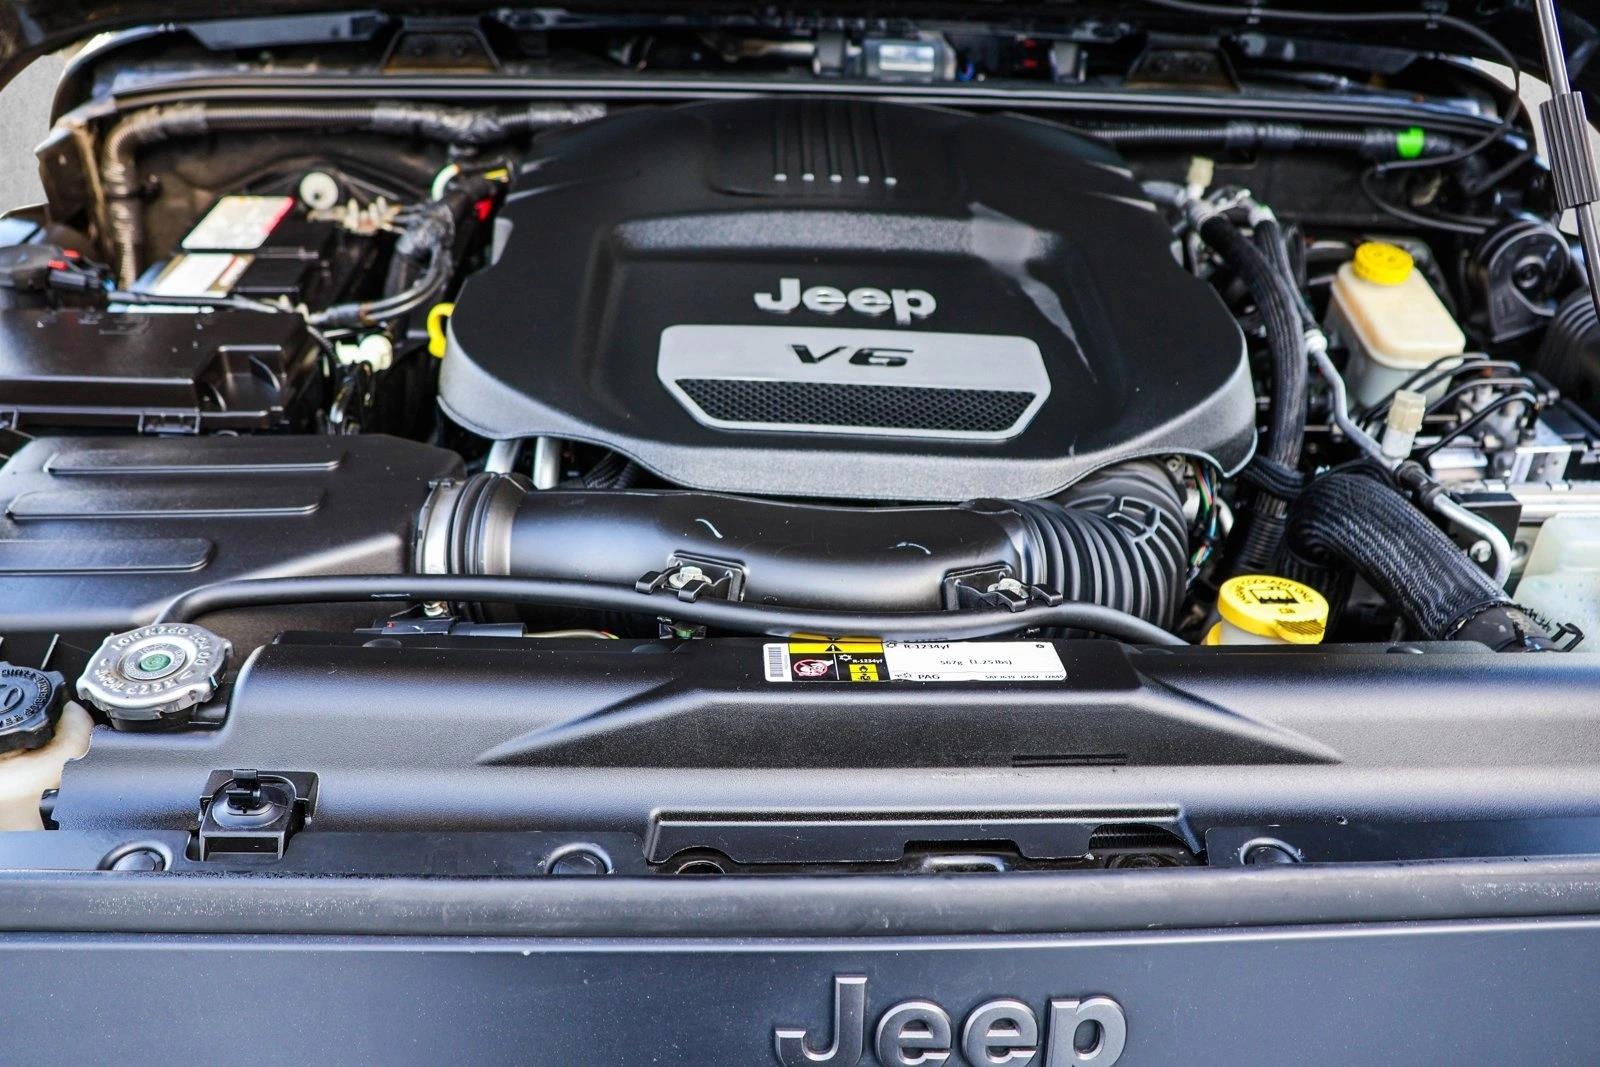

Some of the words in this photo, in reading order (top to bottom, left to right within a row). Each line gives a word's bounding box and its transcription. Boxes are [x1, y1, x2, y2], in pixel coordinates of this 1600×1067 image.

[754, 278, 937, 325] Jeep
[789, 344, 914, 367] V6
[774, 974, 1127, 1067] Jeep
